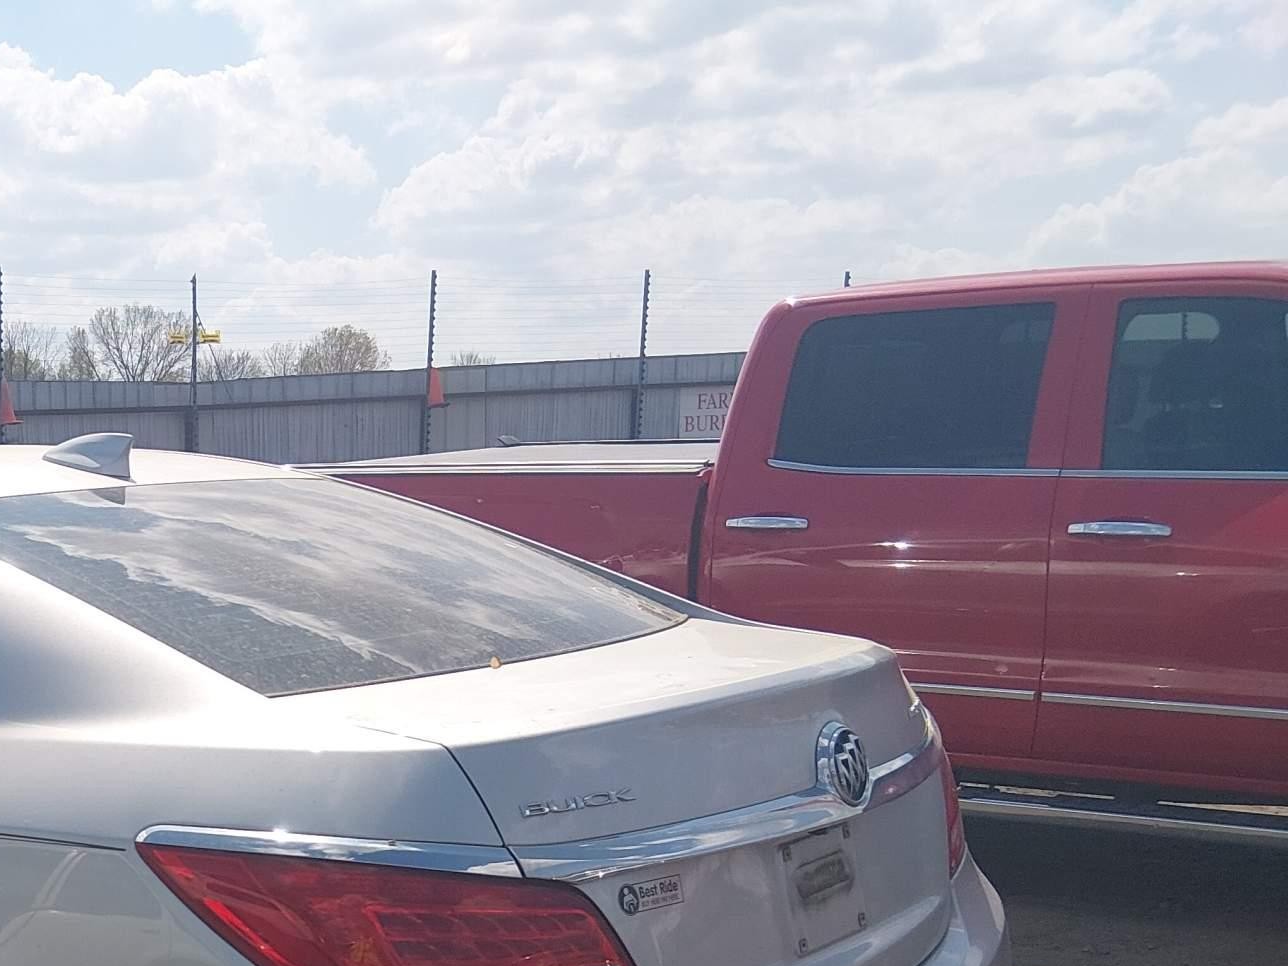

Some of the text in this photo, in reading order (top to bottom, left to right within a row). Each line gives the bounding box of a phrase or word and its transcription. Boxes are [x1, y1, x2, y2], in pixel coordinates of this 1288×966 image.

[519, 787, 637, 818] BUICK
[638, 880, 679, 899] Best Ride
